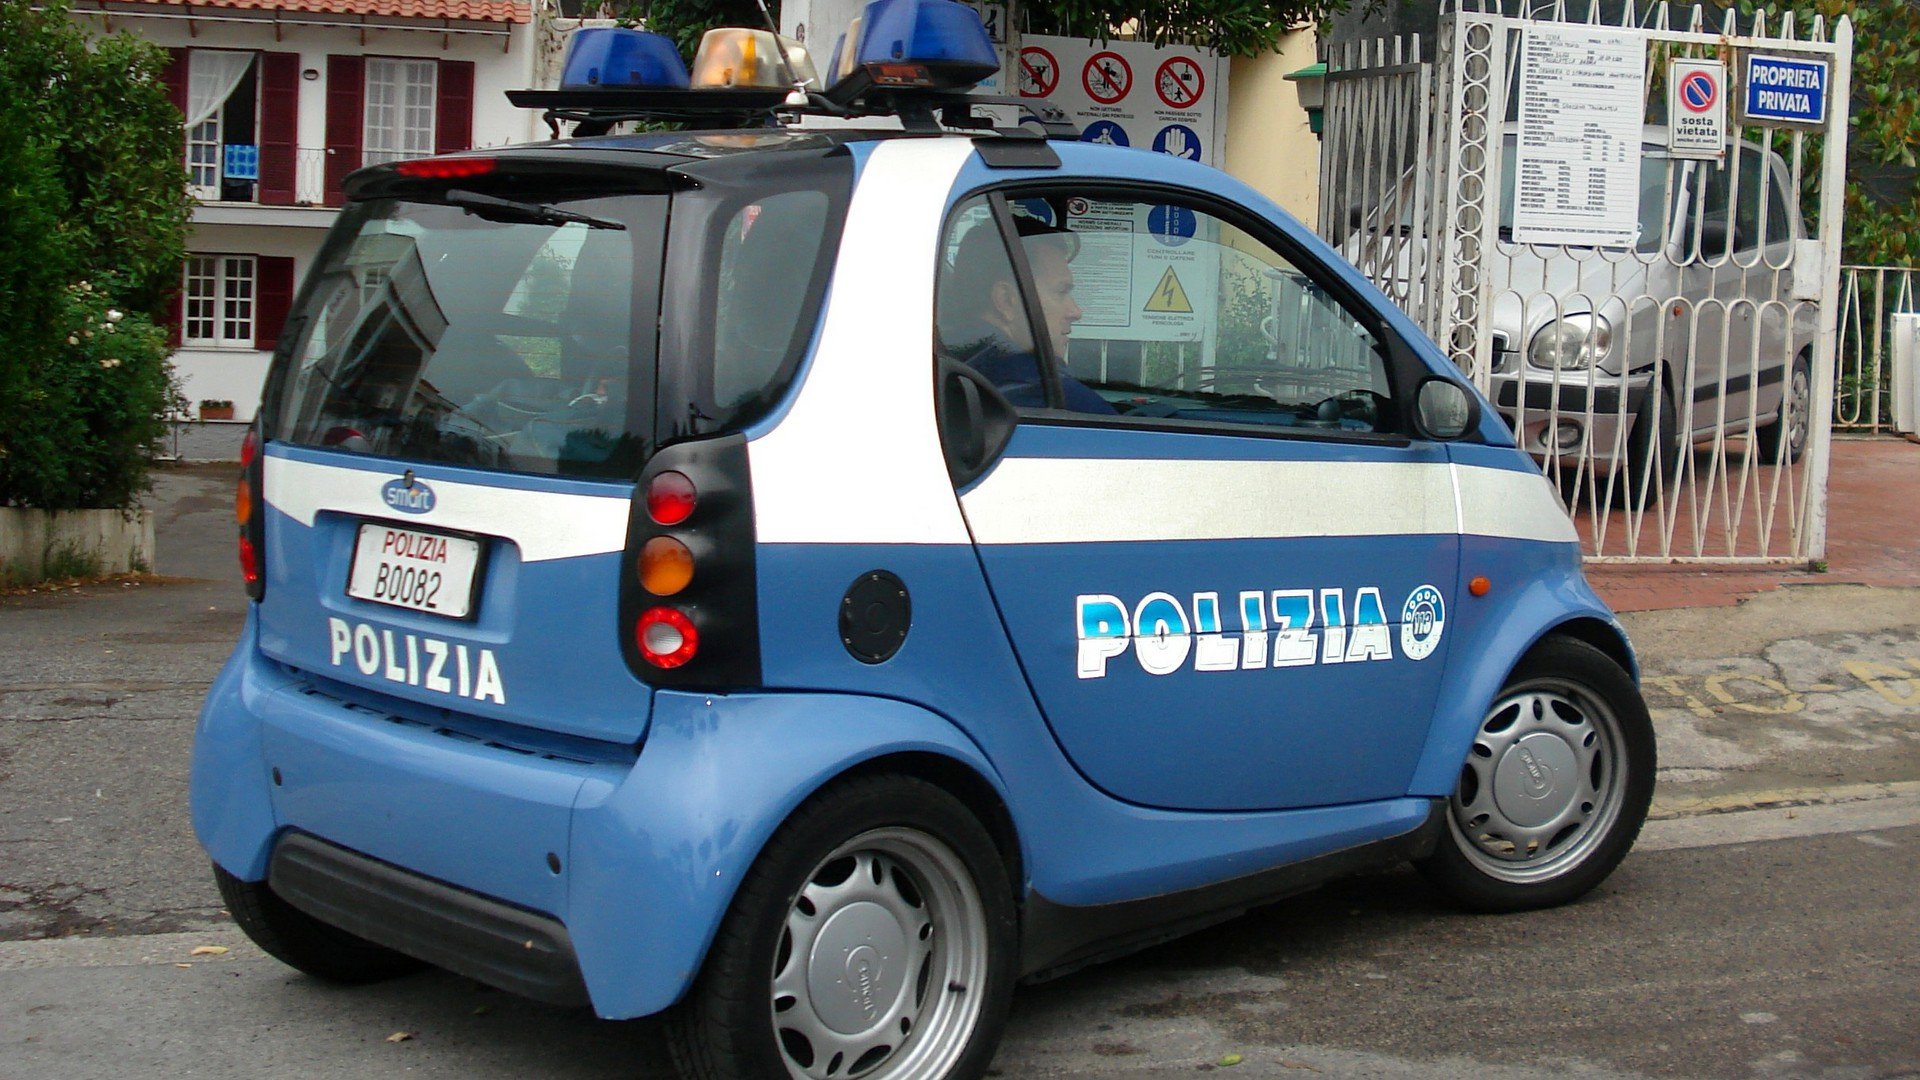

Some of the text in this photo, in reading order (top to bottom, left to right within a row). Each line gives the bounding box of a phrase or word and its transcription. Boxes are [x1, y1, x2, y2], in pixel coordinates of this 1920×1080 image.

[1752, 65, 1820, 90] PROPRIETÀ
[1758, 91, 1811, 113] PRIVATA
[1676, 126, 1718, 136] vietata
[1681, 117, 1713, 126] sosta
[387, 487, 431, 509] smart
[383, 531, 447, 563] POLIZIA
[374, 563, 442, 608] B0082
[1076, 586, 1393, 679] POLIZIA
[329, 617, 506, 705] POLIZIA
